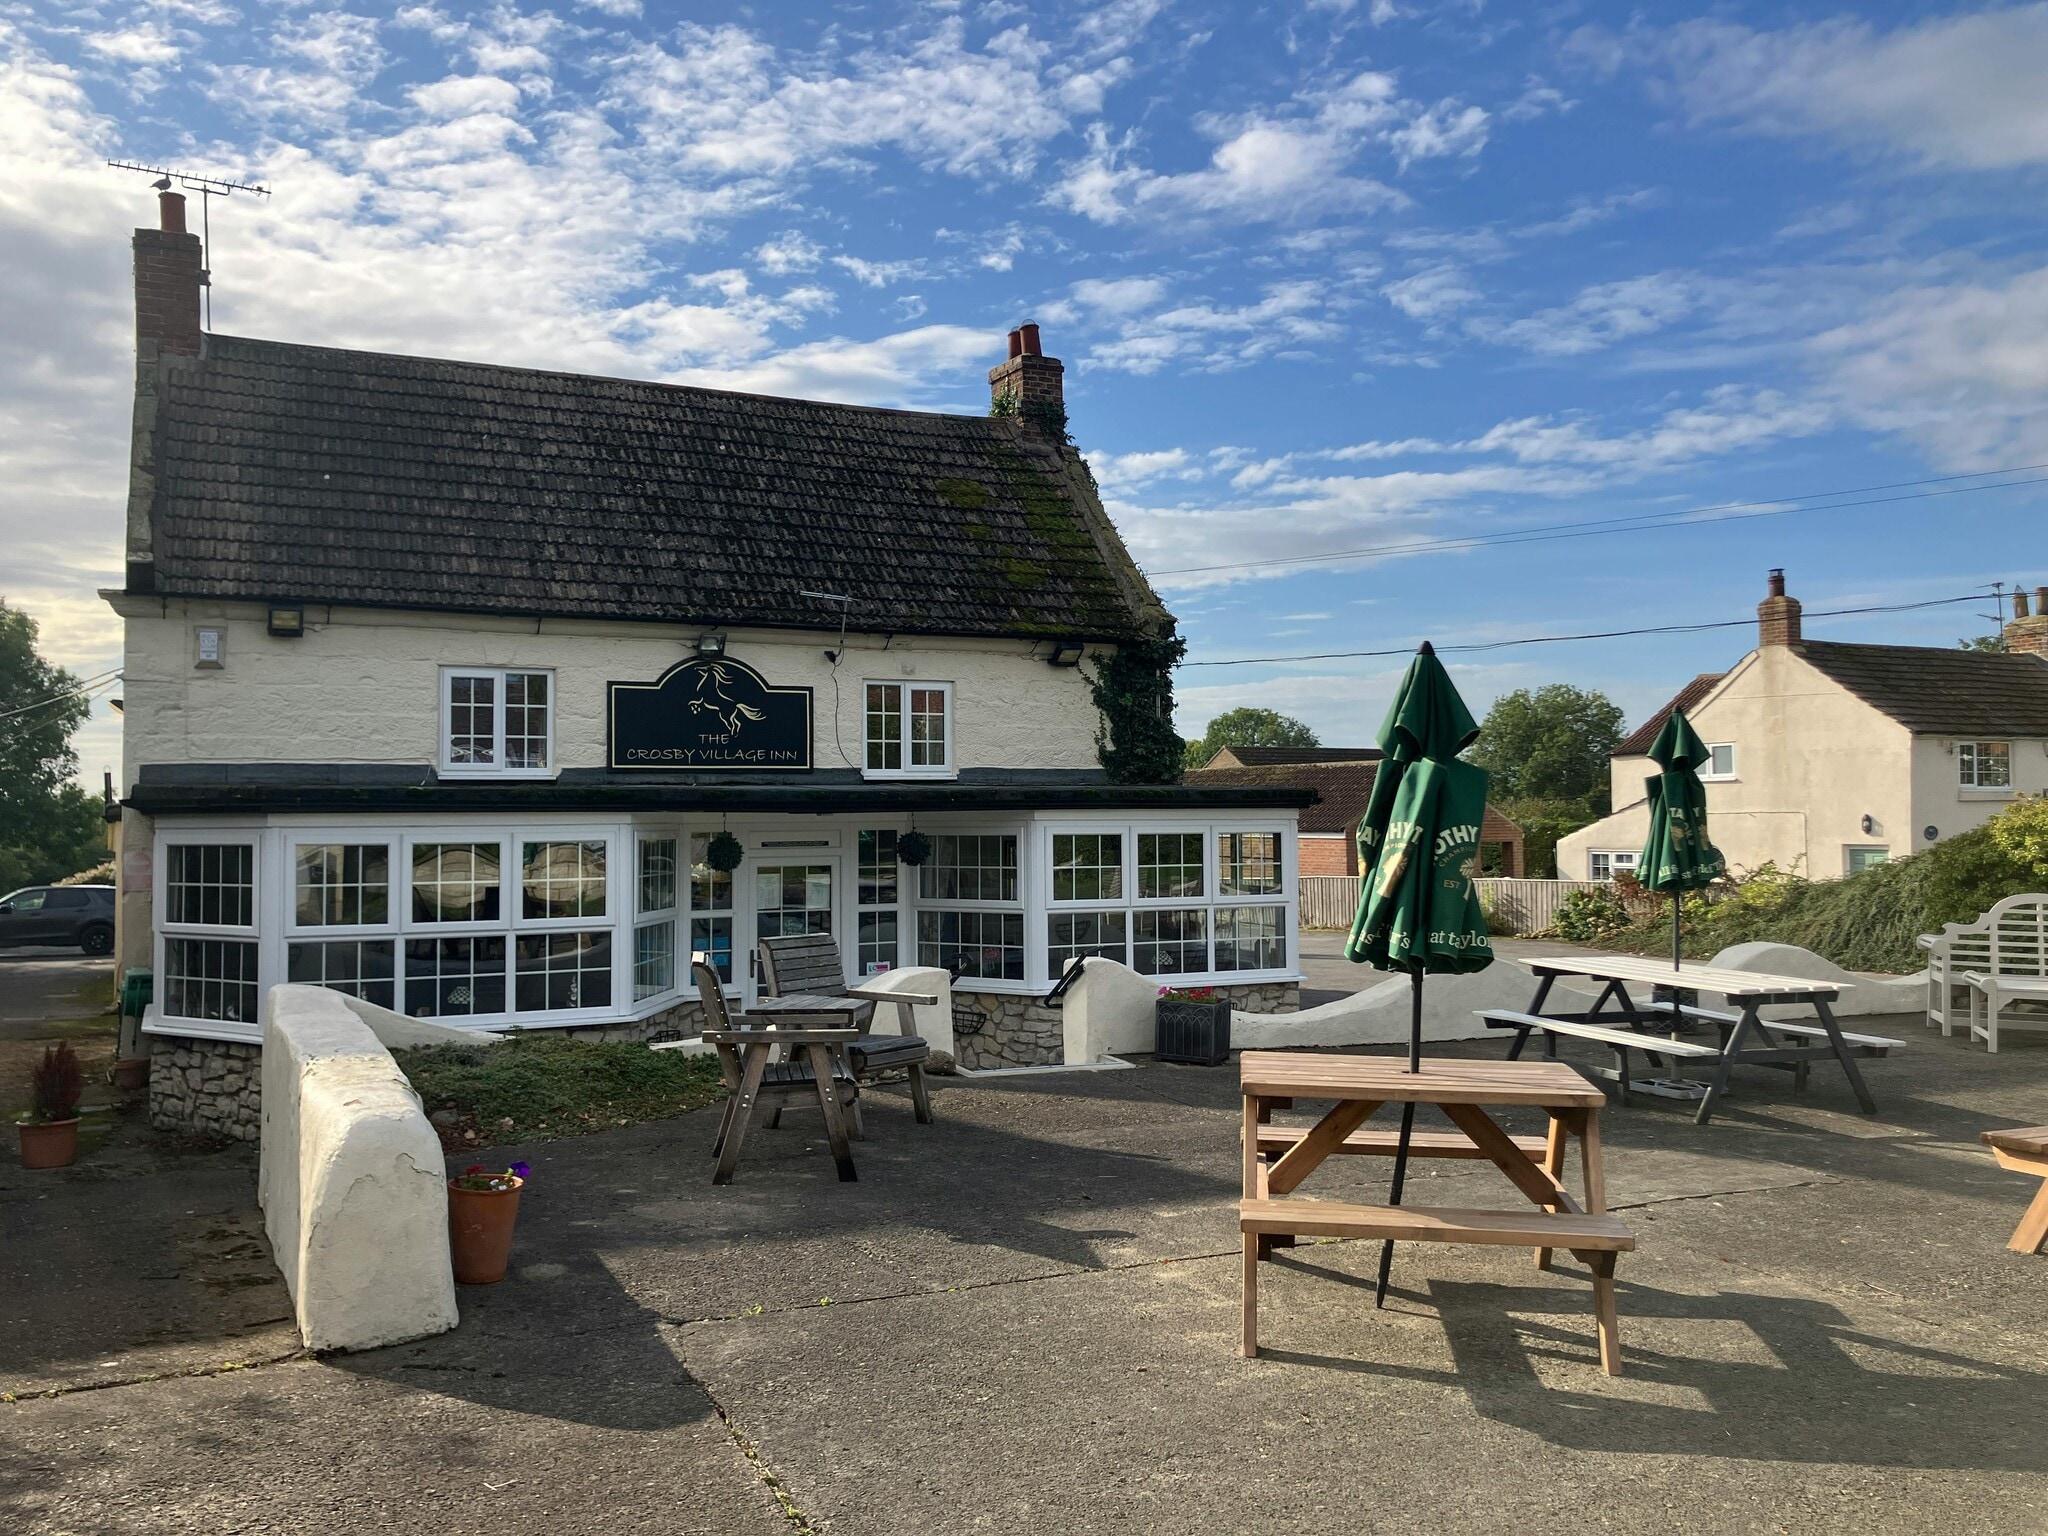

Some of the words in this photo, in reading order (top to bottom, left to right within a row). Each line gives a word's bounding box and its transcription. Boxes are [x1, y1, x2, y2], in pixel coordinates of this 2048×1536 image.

[699, 734, 730, 744] THE
[627, 749, 695, 764] CROSBY
[700, 749, 766, 762] VILLAGE
[770, 750, 797, 760] INN
